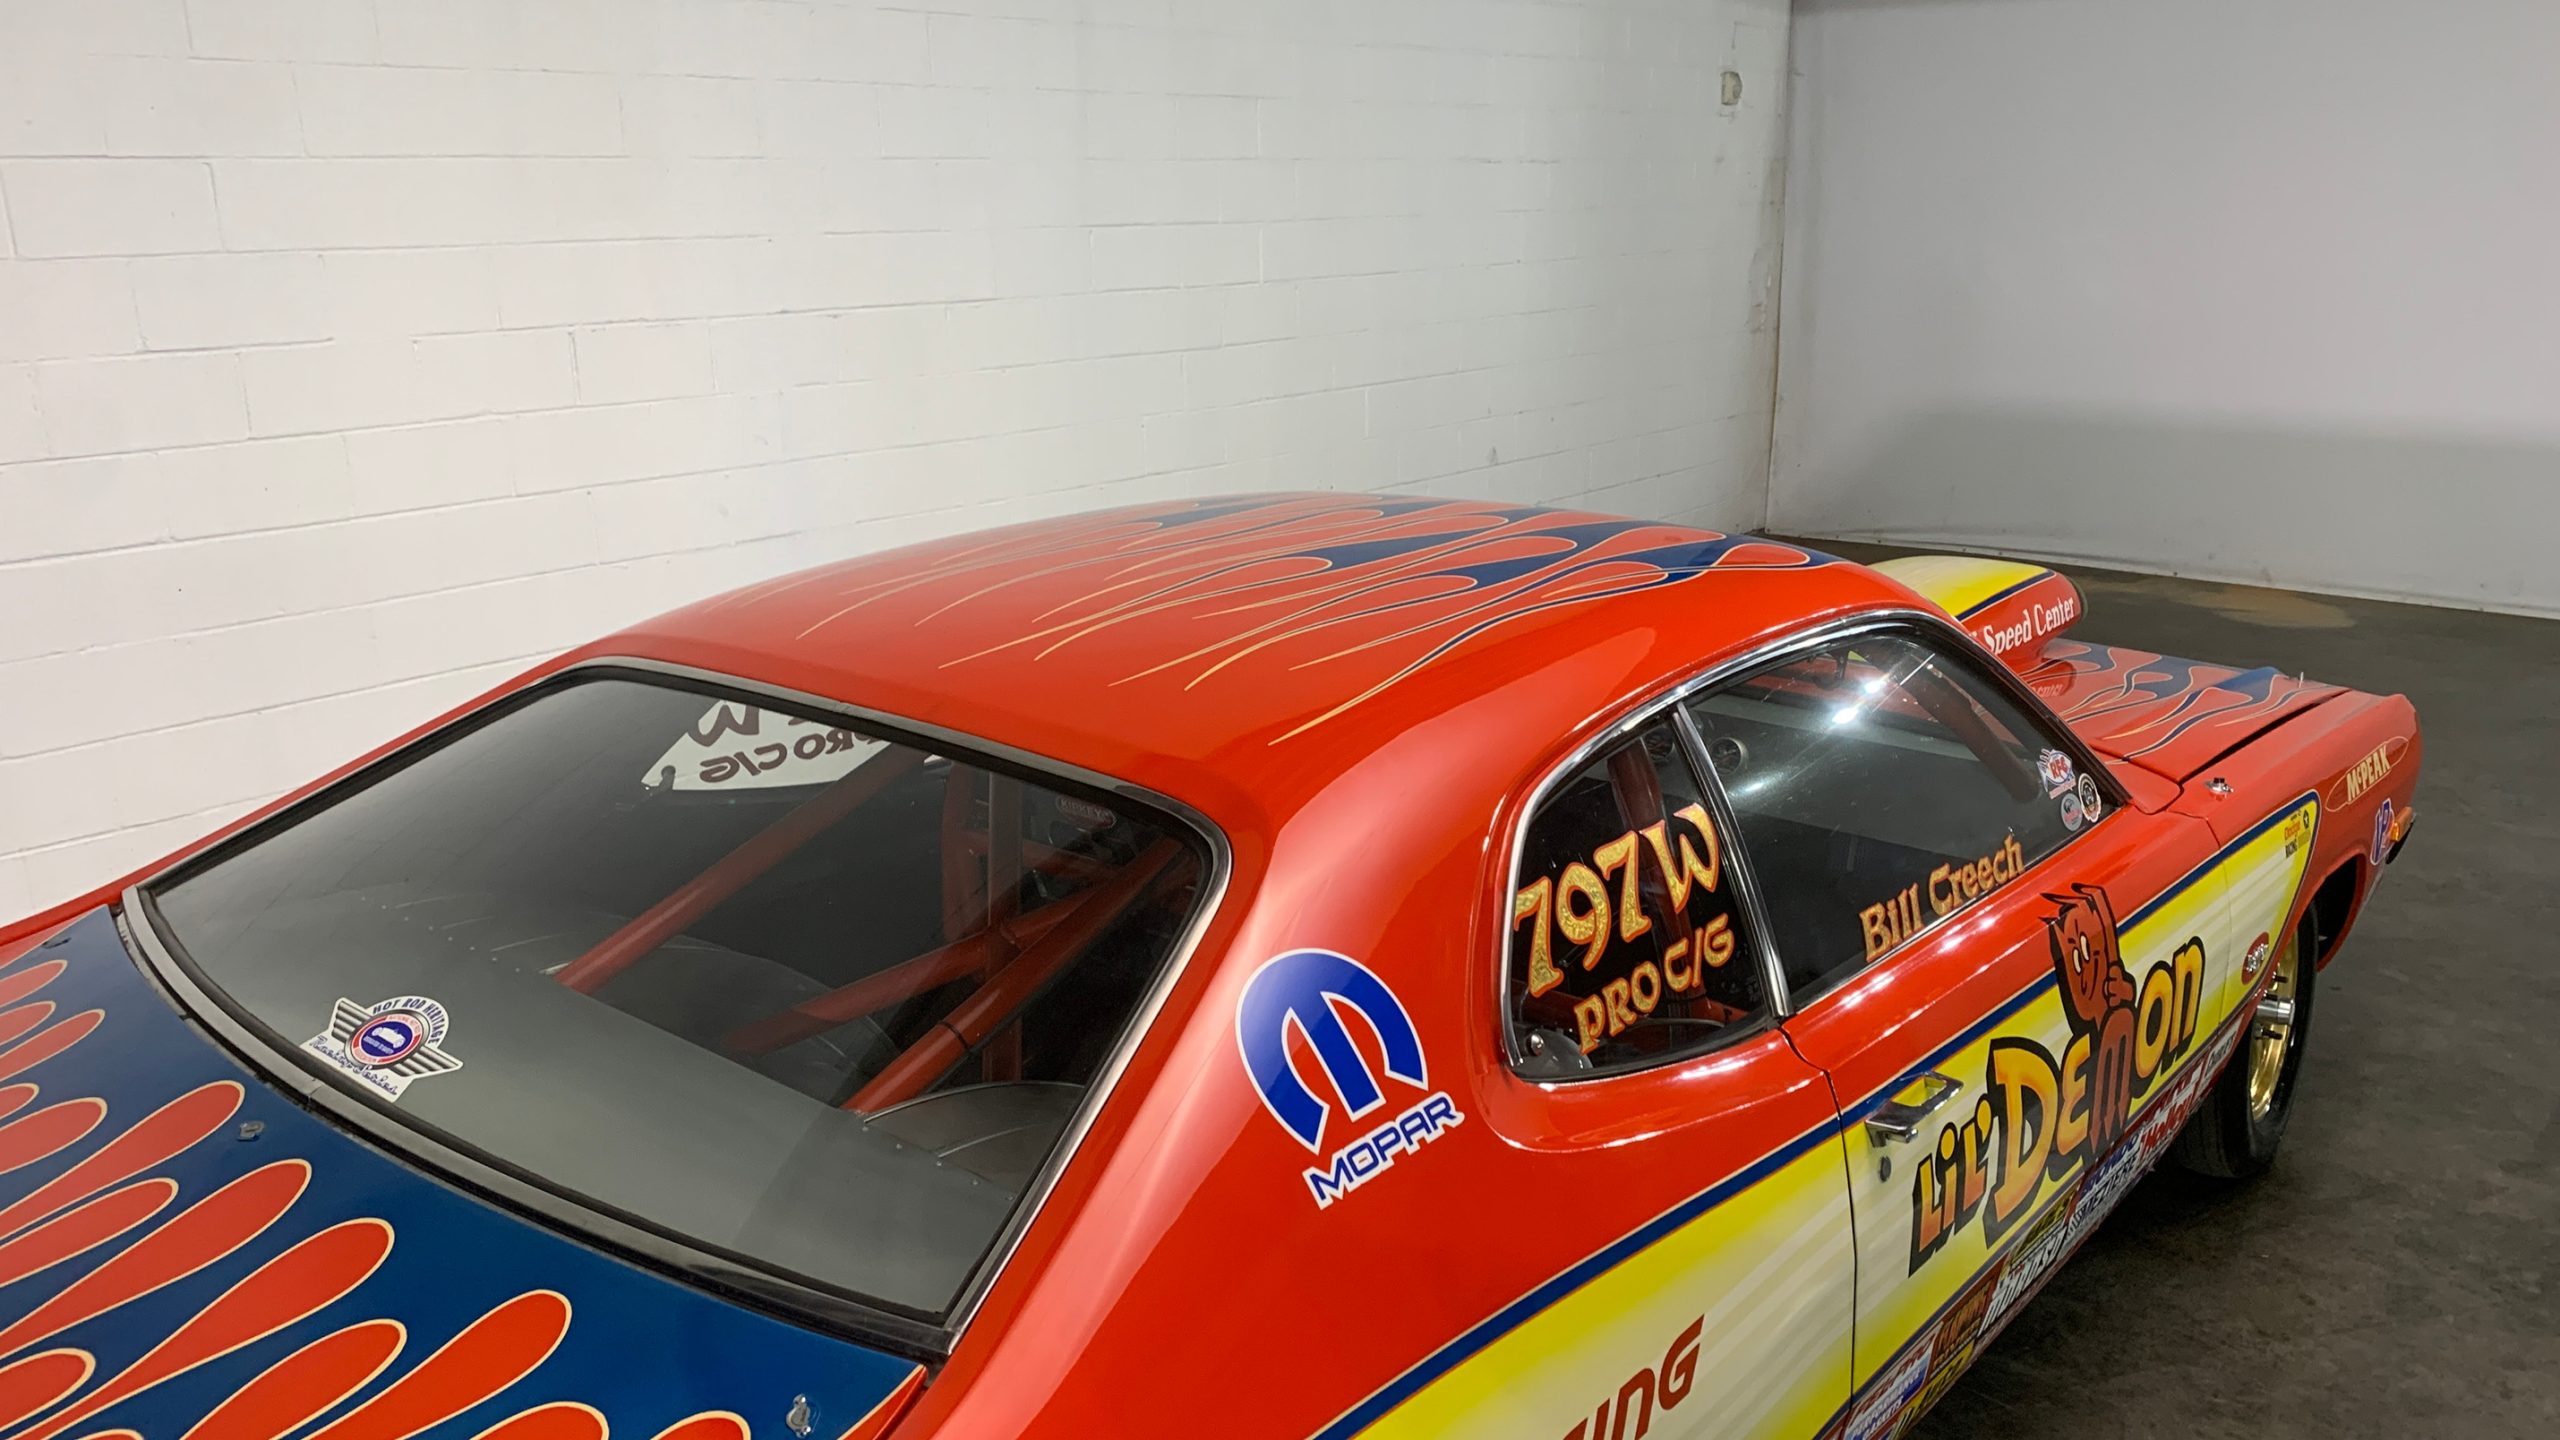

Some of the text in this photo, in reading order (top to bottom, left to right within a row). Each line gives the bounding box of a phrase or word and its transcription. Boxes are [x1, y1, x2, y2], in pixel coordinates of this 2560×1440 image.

[1983, 597, 2074, 655] Speed Center
[2346, 744, 2391, 802] McPEAK
[1858, 833, 2026, 964] Bill Creech
[372, 999, 400, 1015] HOT
[401, 997, 428, 1011] ROD
[422, 1002, 446, 1045] HERITAGE
[1573, 912, 1735, 1056] PRO C/G
[1306, 1094, 1461, 1206] MOPAR
